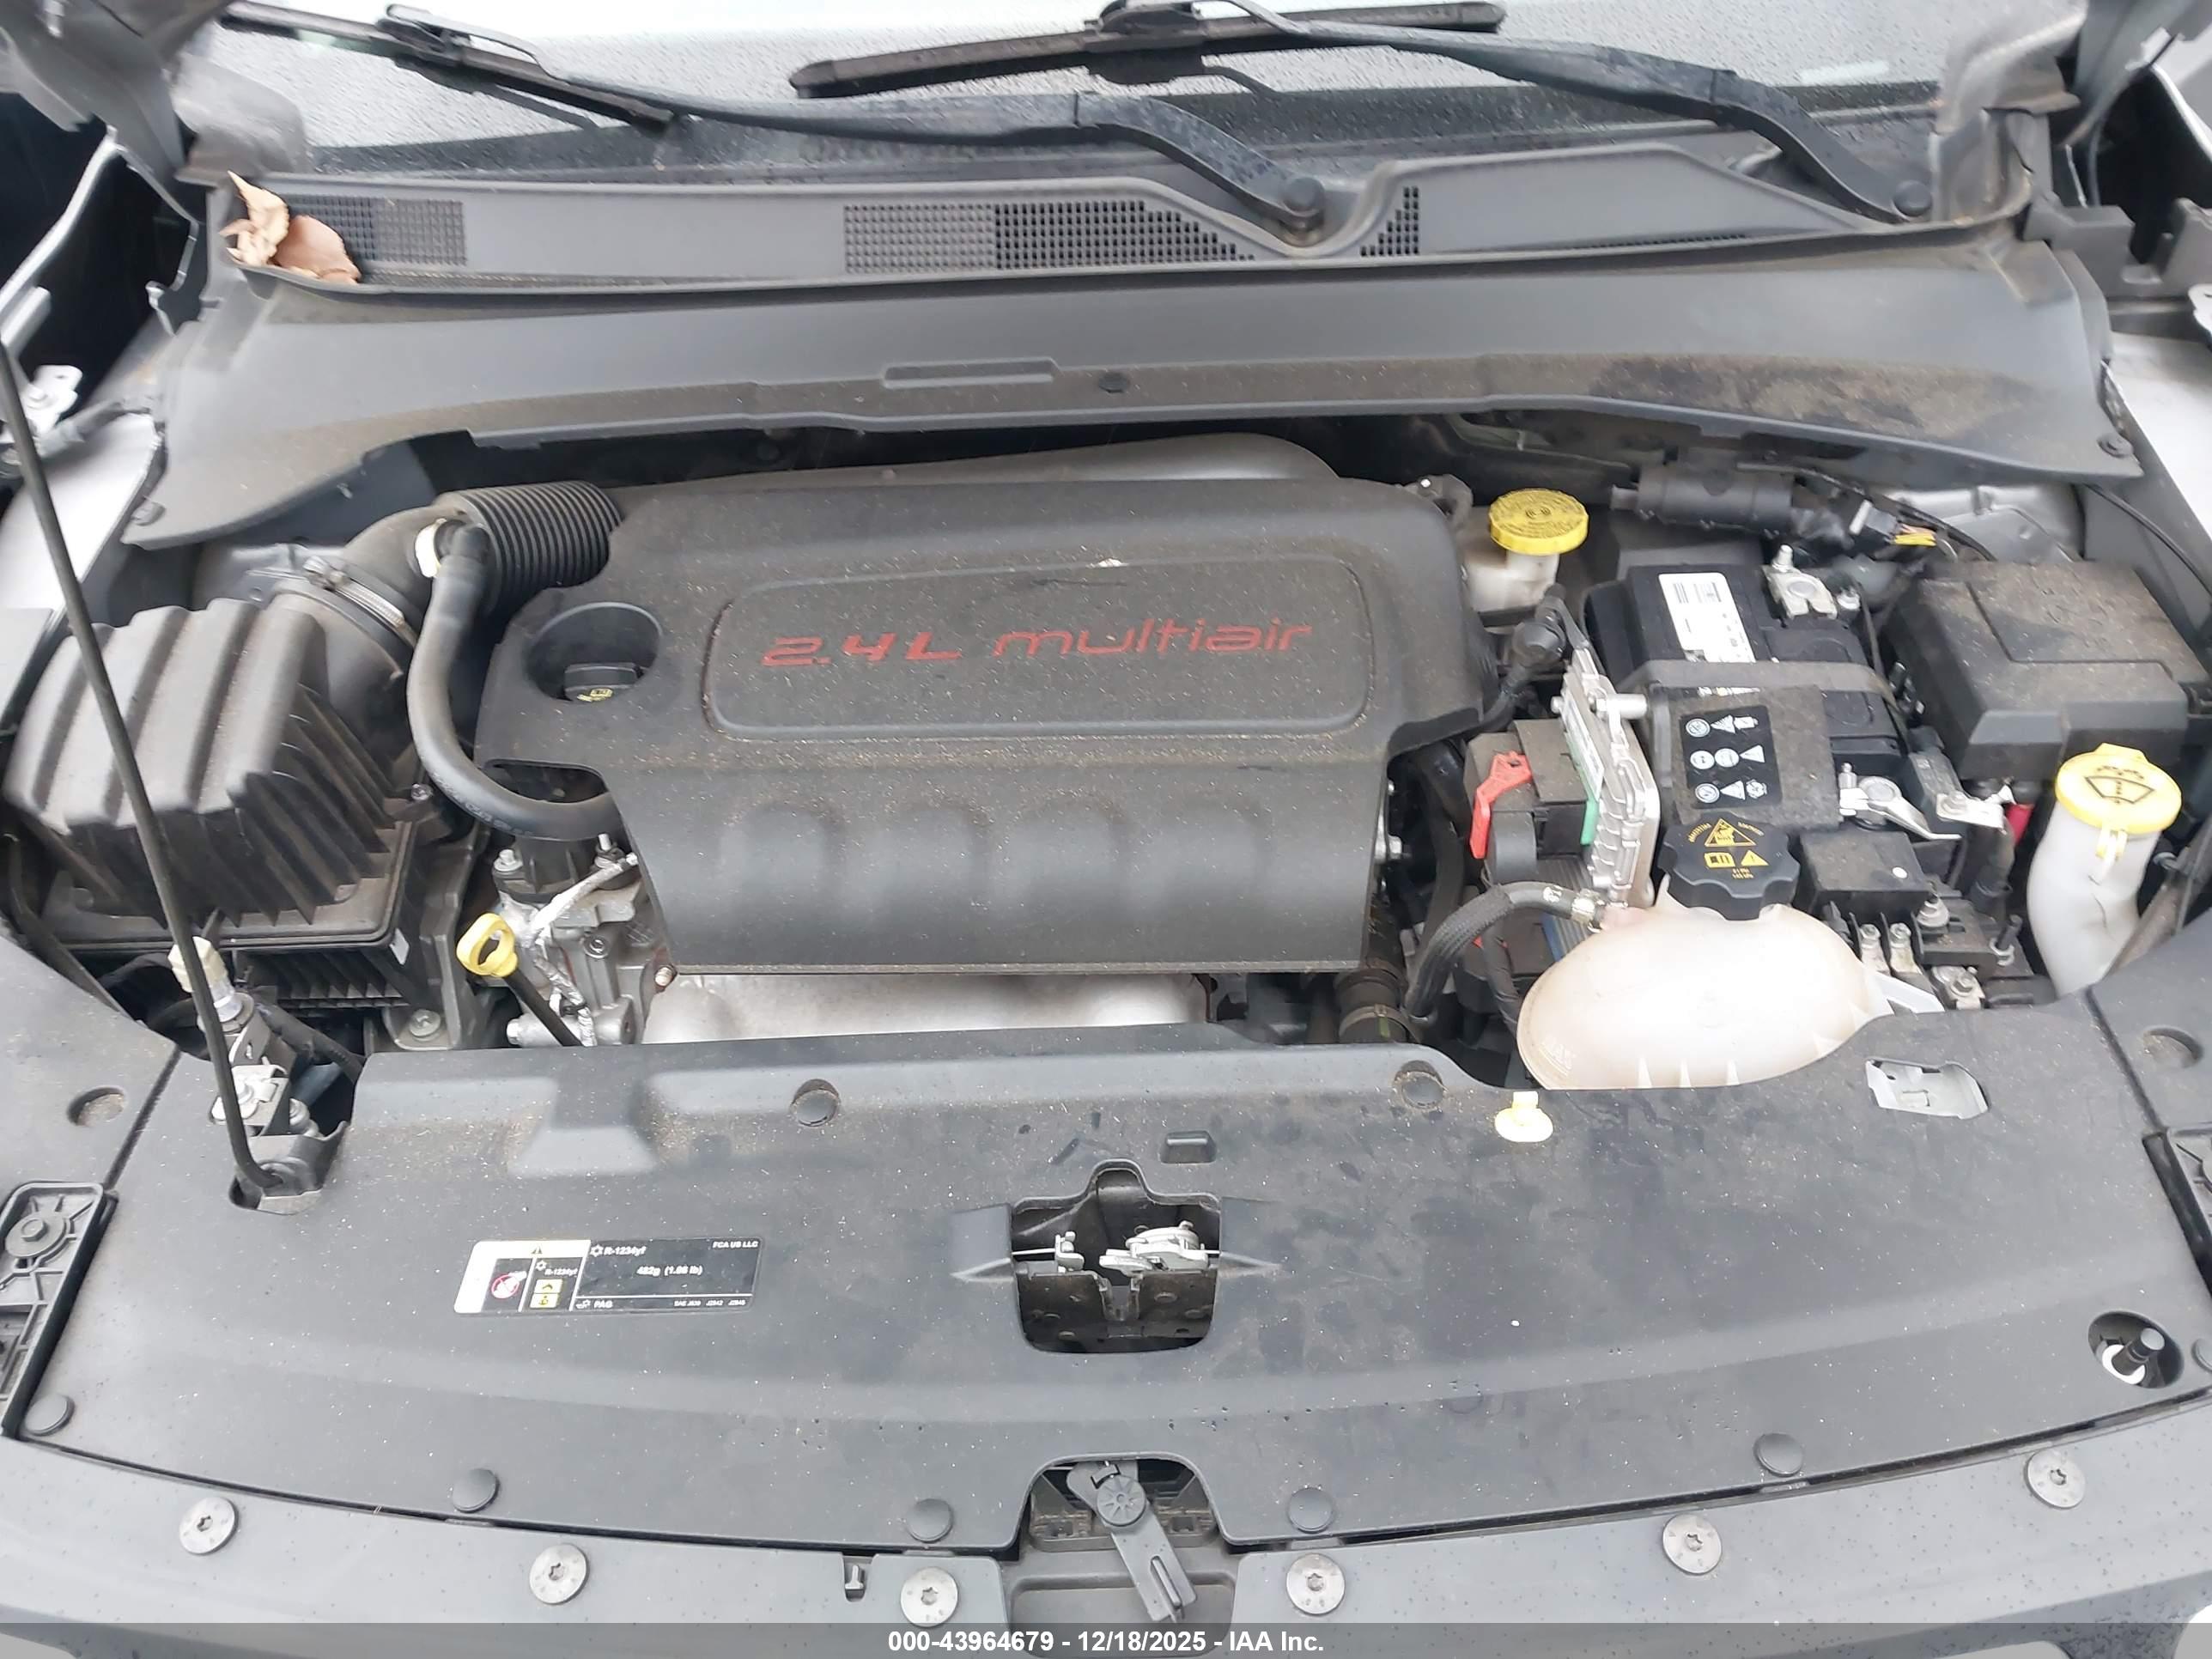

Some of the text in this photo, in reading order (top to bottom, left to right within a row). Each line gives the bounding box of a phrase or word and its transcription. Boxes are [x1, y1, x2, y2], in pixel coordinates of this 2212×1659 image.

[761, 617, 1312, 666] 2.4L multiair
[604, 1246, 647, 1257] R-1234yf
